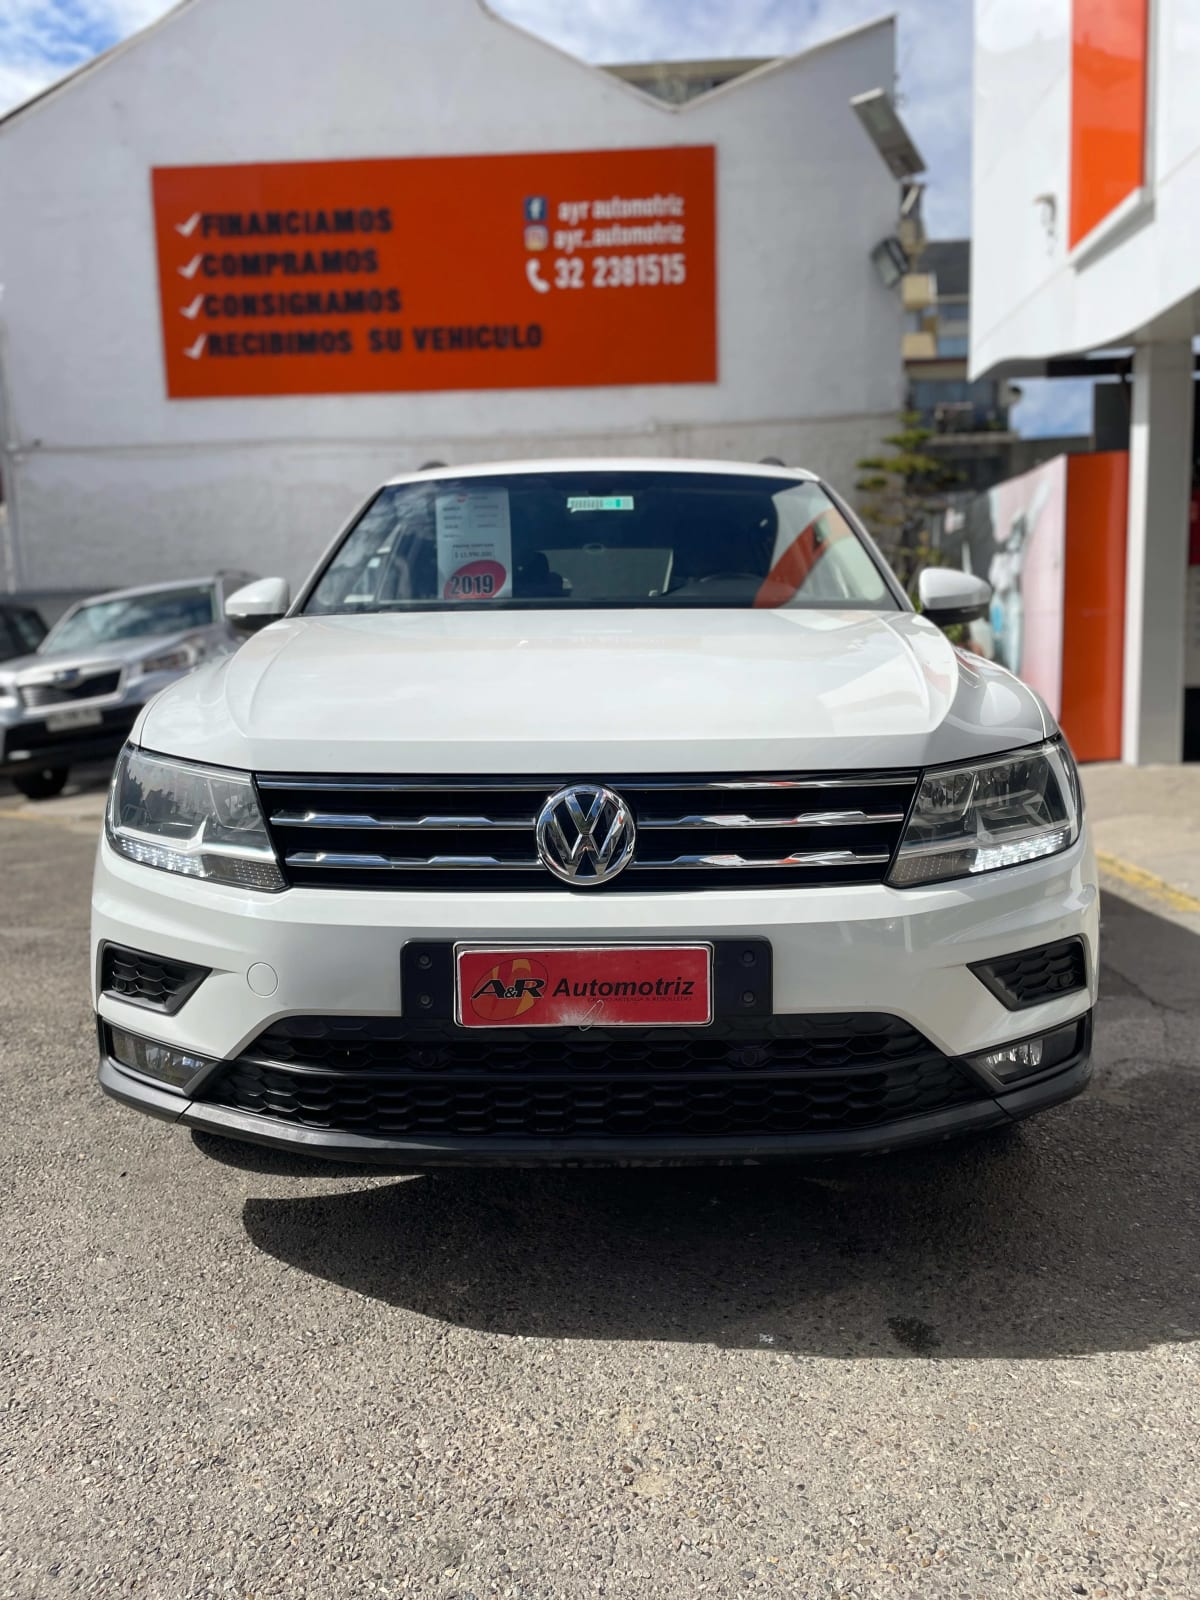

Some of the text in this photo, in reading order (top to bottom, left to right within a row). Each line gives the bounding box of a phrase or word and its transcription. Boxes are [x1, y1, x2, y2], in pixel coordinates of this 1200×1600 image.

[201, 208, 393, 239] FINANCIAMOS
[558, 193, 685, 226] ayr automotriz
[554, 222, 685, 254] ayr_automotriz
[202, 248, 379, 279] COMPRAMOS
[554, 253, 686, 289] 32 2381515
[203, 289, 403, 319] CONSIGNAMOS
[207, 323, 543, 357] RECIBIMOS SU VEHICULO
[450, 575, 494, 595] 2019
[470, 976, 696, 999] A&R Automotriz
